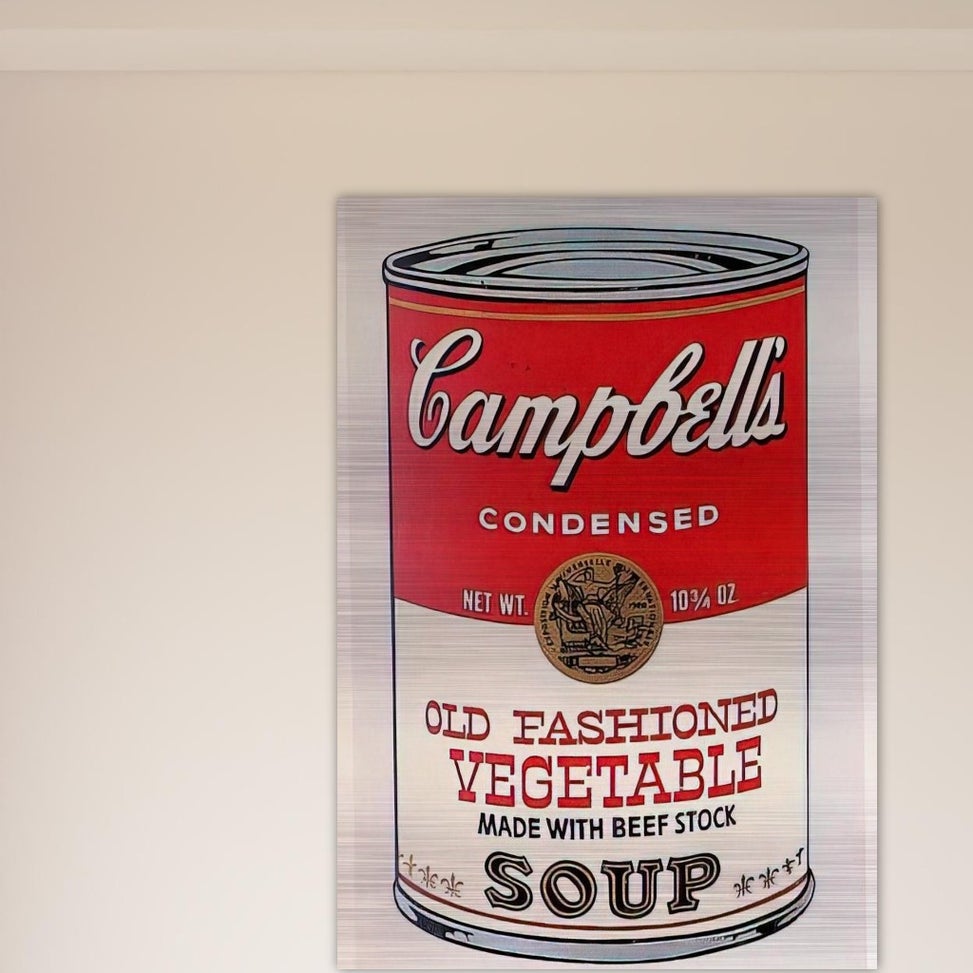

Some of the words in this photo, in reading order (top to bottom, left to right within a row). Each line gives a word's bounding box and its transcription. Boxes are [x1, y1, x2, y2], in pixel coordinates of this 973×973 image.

[408, 327, 788, 492] Campbell's
[478, 505, 720, 536] CONDENSED
[462, 588, 492, 614] NET
[499, 593, 529, 616] WT.
[425, 699, 491, 741] OLD
[512, 688, 778, 745] FASHIONED
[448, 735, 762, 809] VEGETABLE
[477, 811, 541, 839] MADE
[545, 817, 604, 841] WITH
[612, 814, 669, 838] BEEF
[674, 804, 737, 835] STOCK
[483, 850, 721, 919] SOUP
